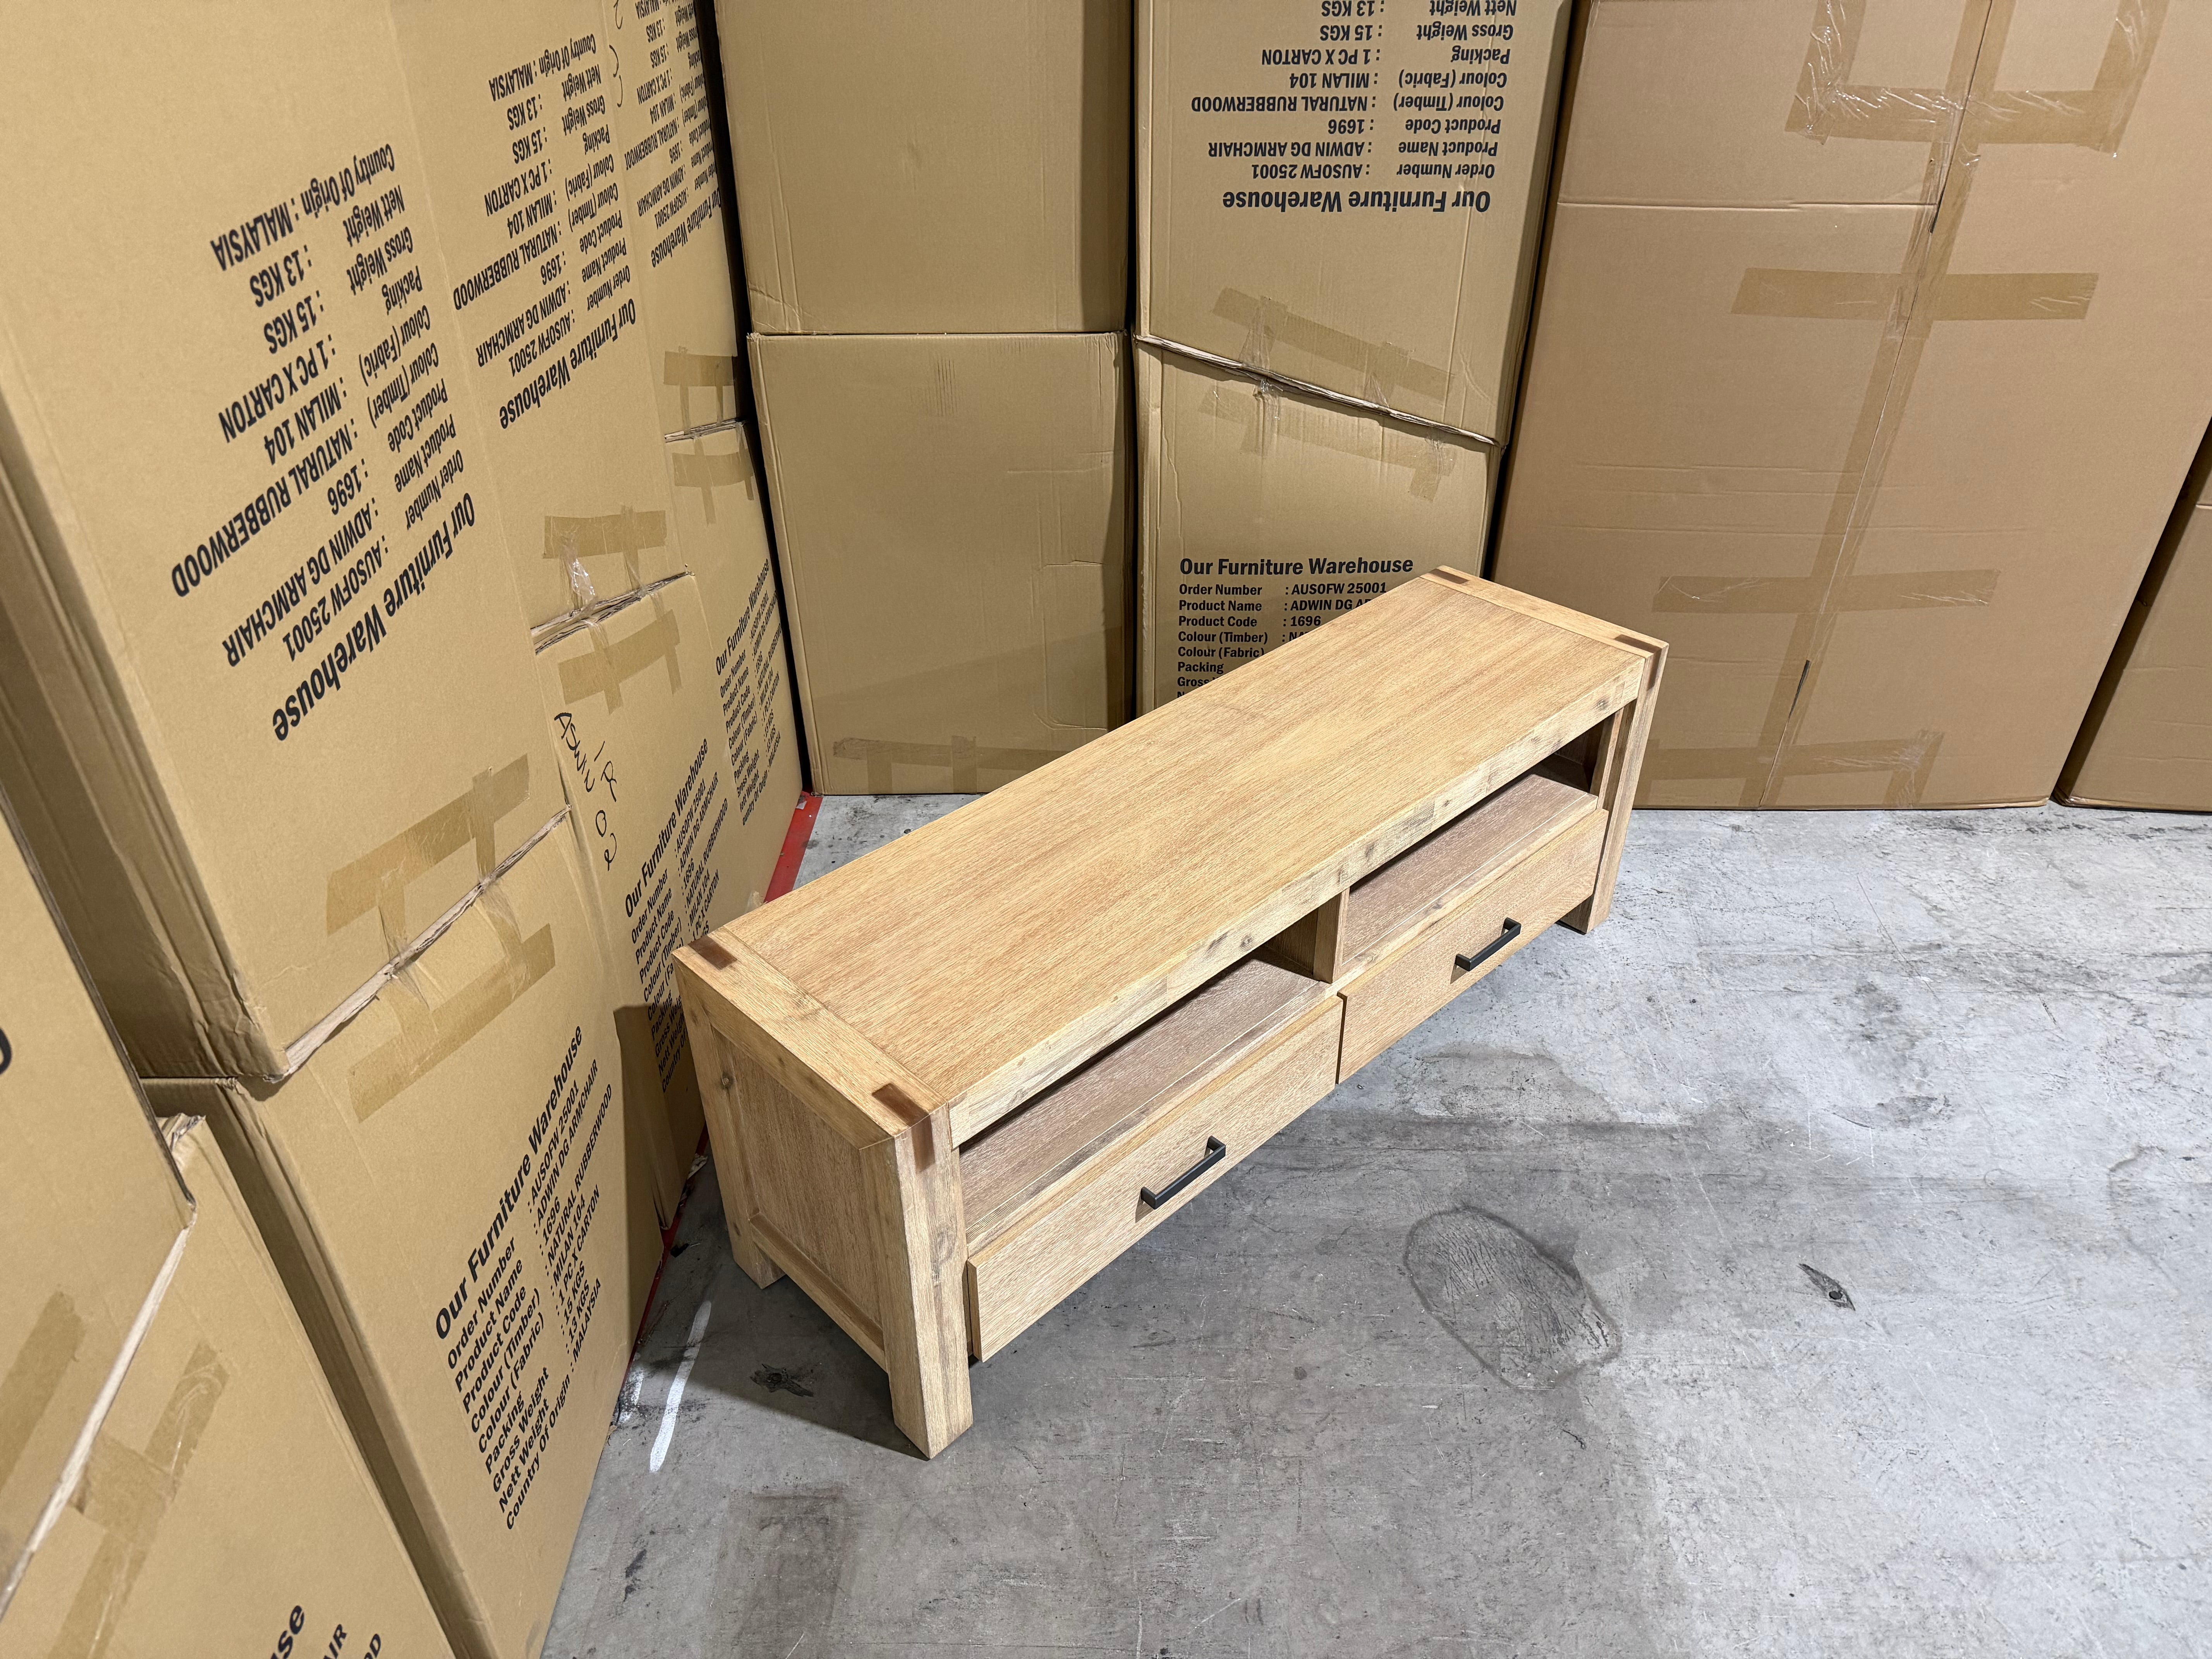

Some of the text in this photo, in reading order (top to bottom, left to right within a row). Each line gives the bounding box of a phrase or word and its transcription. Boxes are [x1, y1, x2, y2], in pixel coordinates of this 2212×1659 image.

[650, 45, 666, 69] 15 KGS
[1320, 21, 1513, 41] Gross Weight 15 KGS
[637, 79, 656, 105] CARTON
[1192, 93, 1504, 112] Colour (Timber) NATURAL RUBBERWOOD
[1290, 69, 1507, 88] Colour (Fabric) MILAN 104
[657, 118, 678, 146] NATURAL
[1328, 119, 1501, 134] Product Code 1696
[210, 144, 395, 271] Country Of Origin MALAYSIA
[507, 154, 614, 239] Colour (Fabric) MILAN 104
[637, 165, 684, 217] ADWIN DG ARMCHAIR
[654, 188, 687, 229] AUSOFW 25001
[1223, 191, 1490, 212] Our Furniture Warehouse
[1252, 164, 1495, 179] Order Number AUSOFW 25001
[453, 183, 618, 310] Colour (Timber) NATURAL RUBBERWOOD
[541, 210, 623, 285] Product Code 1696
[651, 196, 712, 268] Furniture Warehouse
[476, 237, 627, 367] Product Name ADWIN DG ARMCHAIR
[508, 265, 630, 377] Order Number AUSOFW 25001
[218, 266, 422, 443] Packing 1 PC X CARTON
[500, 299, 635, 429] Our Furniture Warehouse
[172, 343, 438, 597] Colour (Timber) NATURAL RUBBERWOOD
[222, 414, 456, 666] Product Name ADWIN DG ARMCHAIR
[283, 450, 463, 661] Order Number AUSOFW 25001
[1180, 557, 1413, 575] Our Furniture Warehouse
[273, 493, 474, 741] Our Furniture Warehouse
[716, 558, 769, 675] Our Furniture Warehouse
[1179, 600, 1225, 611] Product
[1228, 600, 1262, 611] Name
[1290, 599, 1332, 611] ADWIN
[1335, 599, 1353, 611] DG
[1179, 616, 1321, 627] Product Code 1696
[1180, 582, 1387, 595] Order Number AUSOFW 25001
[720, 649, 745, 698] Order Number
[1178, 631, 1267, 645] Colour (Timber)
[1178, 646, 1265, 659] Colour (Fabric)
[1178, 662, 1224, 674] Packing
[726, 685, 750, 734] Product Code
[625, 738, 708, 917] Our Furniture Warehouse
[632, 778, 706, 944] Order Number AUSOFW 25001
[635, 772, 718, 965] Product Name ADWIN DG ARMCHAIR
[644, 798, 728, 1002] Colour (Timber) NATURAL RUBBERWOOD
[436, 1026, 582, 1339] Our Furniture Warehouse
[448, 1080, 579, 1369] Order Number AUSOFW 25001
[455, 1059, 598, 1393] Product Name ADWIN DG ARMCHAIR
[486, 1184, 599, 1475] Packing 1 PC X CARTON
[499, 1279, 589, 1513] Nett Weight 13 KGS
[507, 1278, 601, 1529] Country Of Origin MALAYSIA
